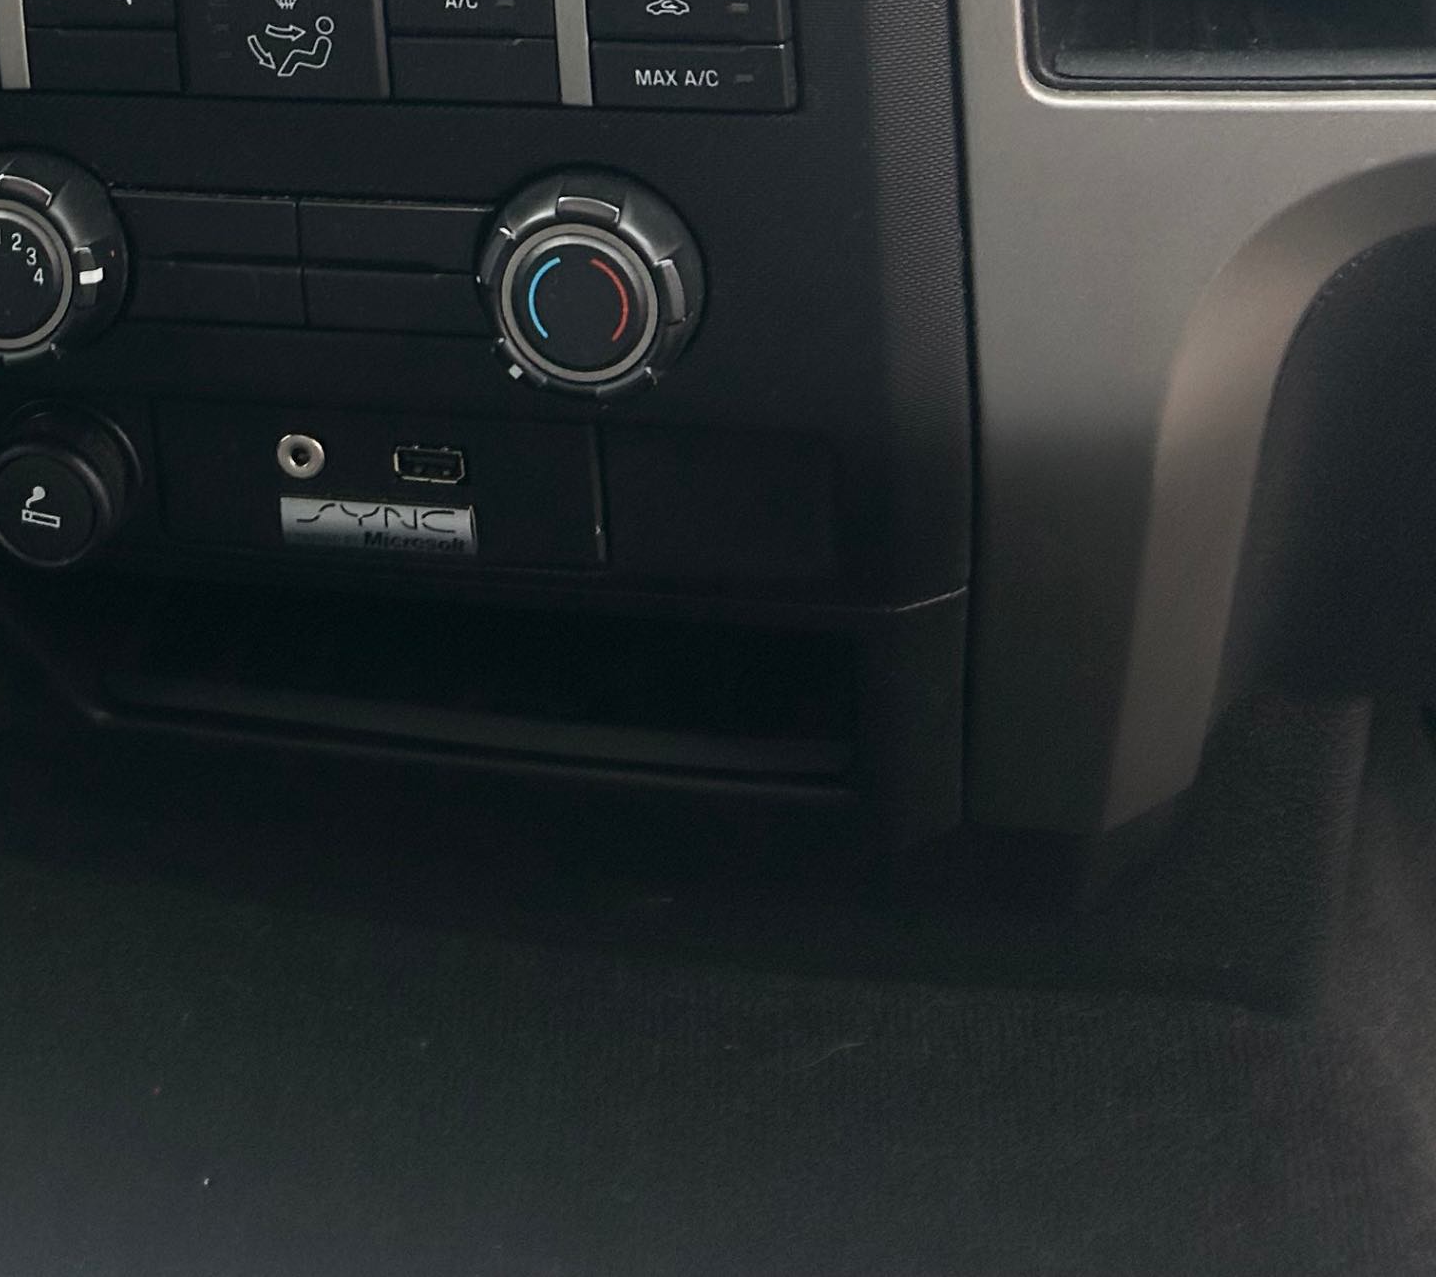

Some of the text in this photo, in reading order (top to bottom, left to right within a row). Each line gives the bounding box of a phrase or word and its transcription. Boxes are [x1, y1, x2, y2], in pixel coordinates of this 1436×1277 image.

[634, 69, 720, 88] MAX A/C
[11, 232, 23, 252] 2
[26, 246, 38, 266] 3
[33, 267, 45, 286] 4
[296, 502, 456, 534] SYNC
